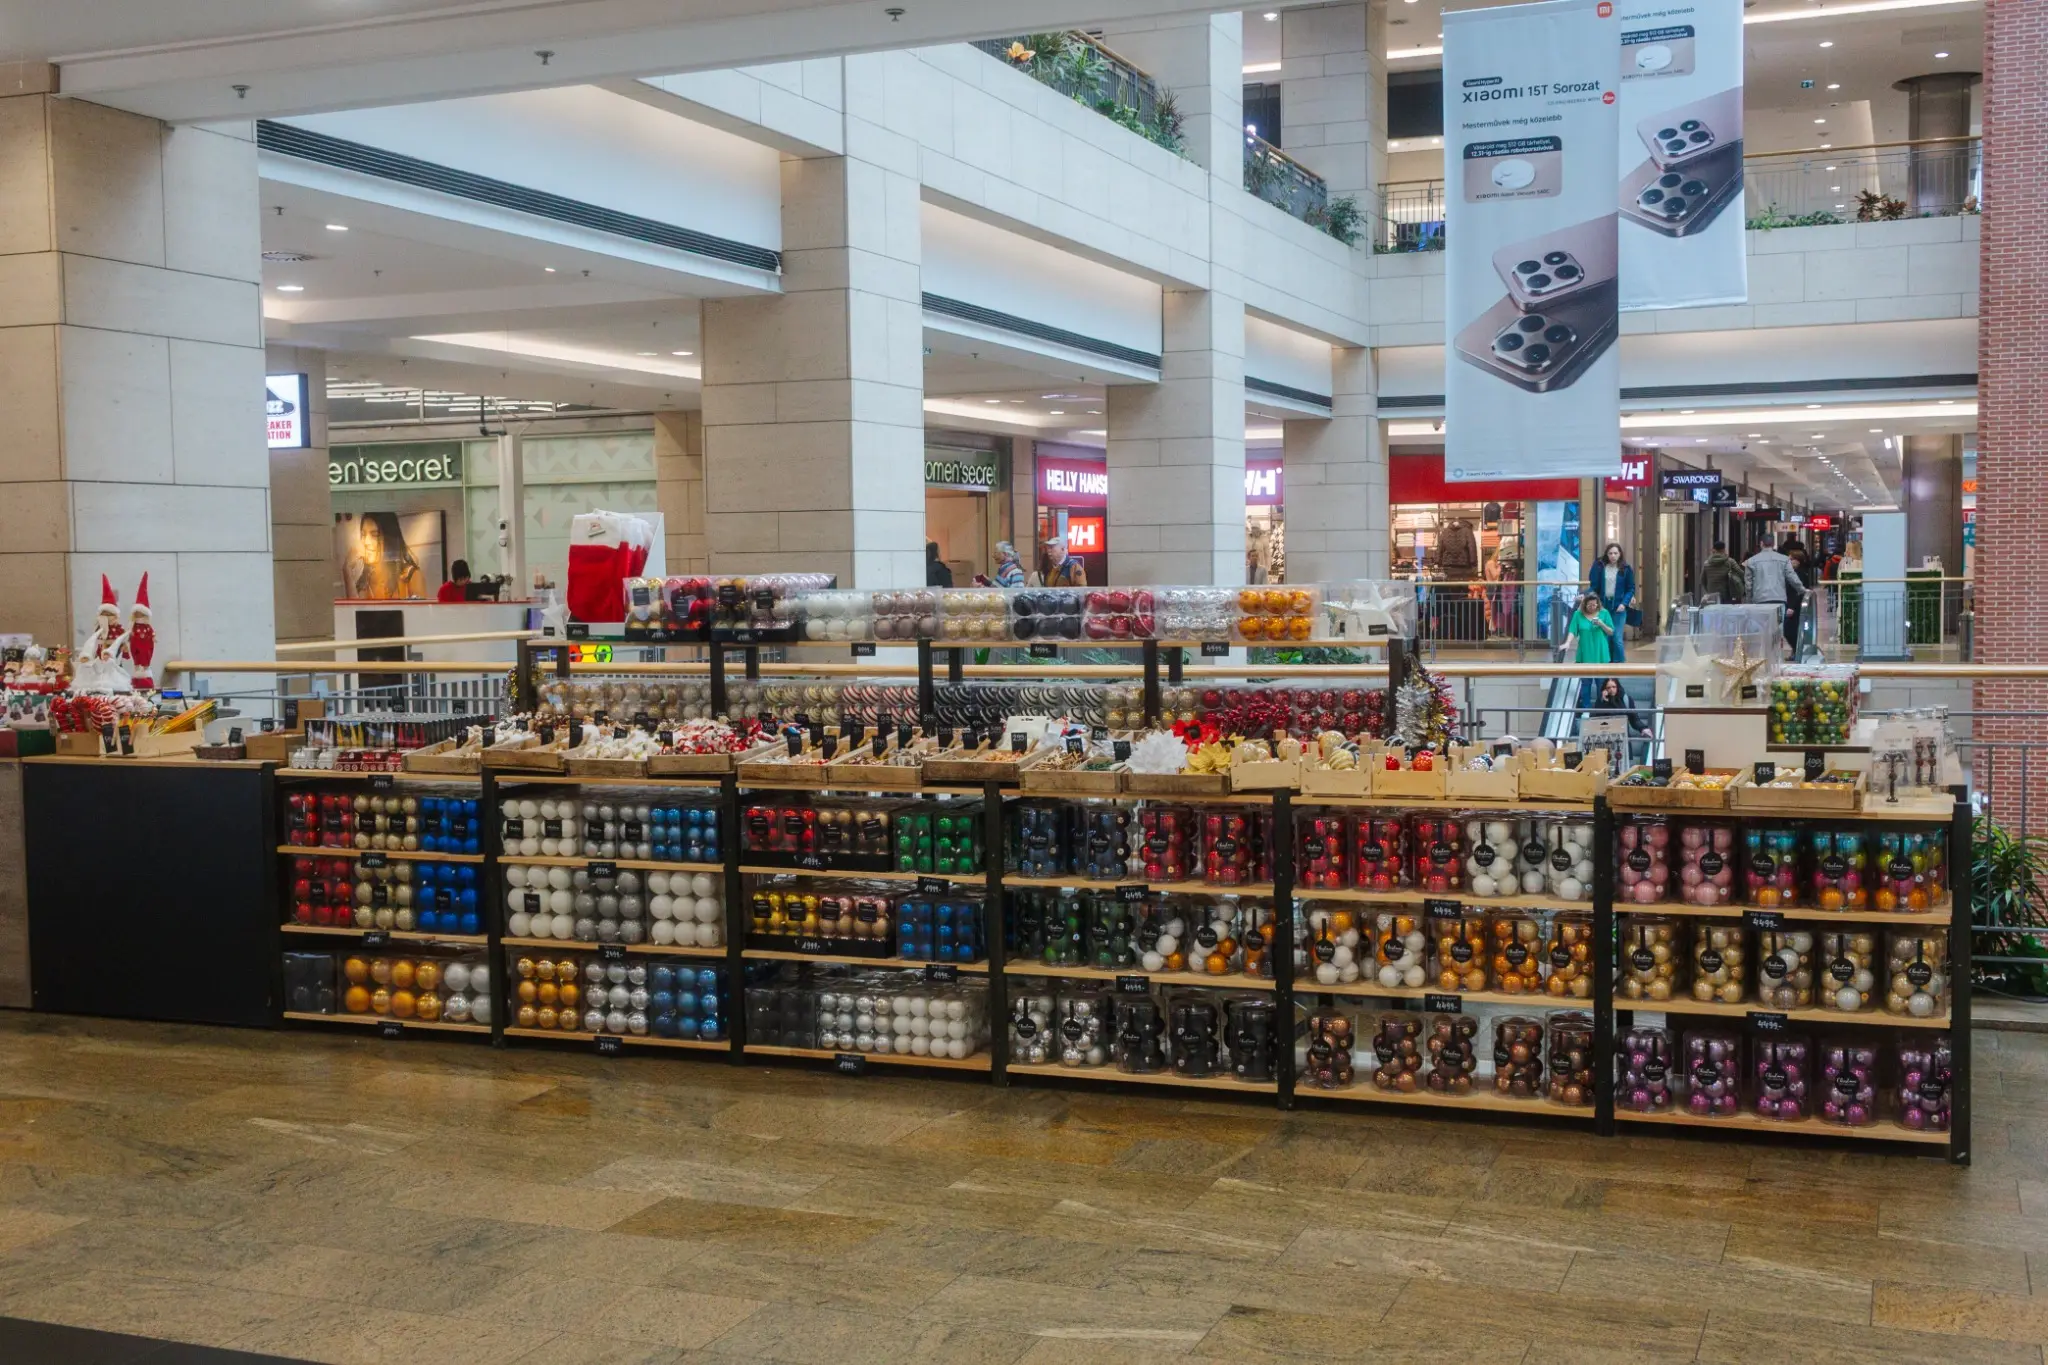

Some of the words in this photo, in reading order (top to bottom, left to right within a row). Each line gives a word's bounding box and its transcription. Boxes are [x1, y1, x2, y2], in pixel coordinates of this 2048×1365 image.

[1527, 84, 1549, 97] 15T
[1553, 80, 1600, 94] Sorozat
[1462, 118, 1510, 129] Mesterművek
[1512, 116, 1528, 126] még
[1530, 114, 1563, 123] közelebb
[329, 454, 453, 484] en'secret
[1046, 469, 1078, 492] HELLY
[1672, 474, 1719, 484] SWAROVSKI
